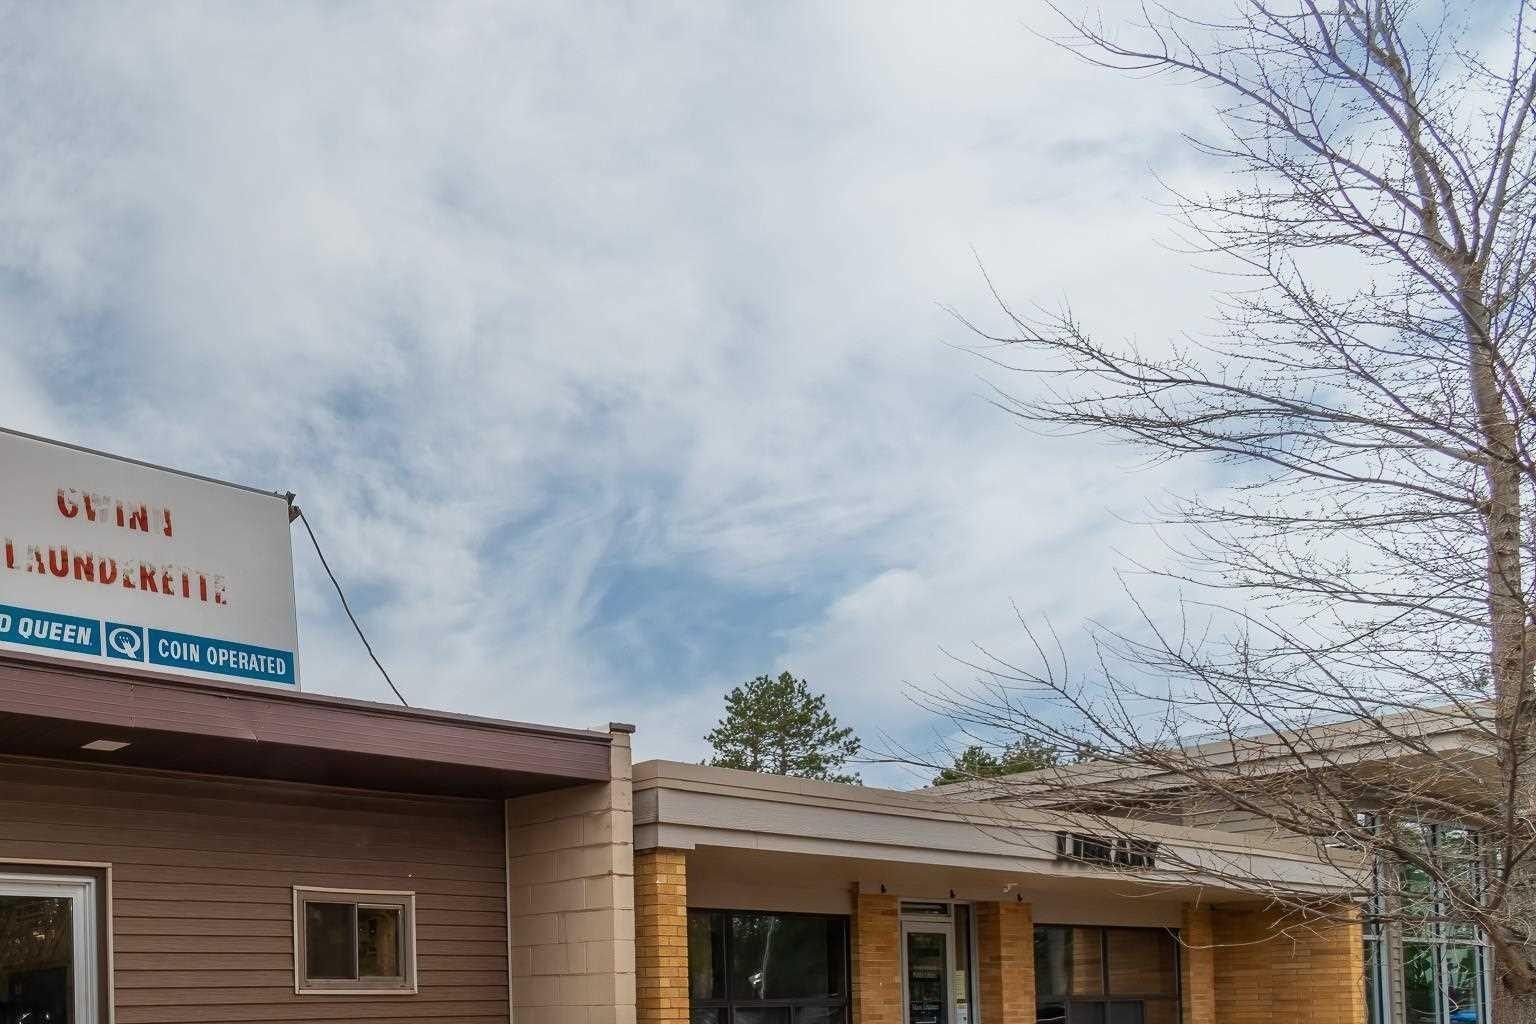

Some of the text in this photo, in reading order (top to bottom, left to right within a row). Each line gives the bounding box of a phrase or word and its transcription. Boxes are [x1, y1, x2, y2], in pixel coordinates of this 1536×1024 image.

[18, 616, 92, 646] QUEEN
[157, 638, 287, 677] COIN OPERATED
